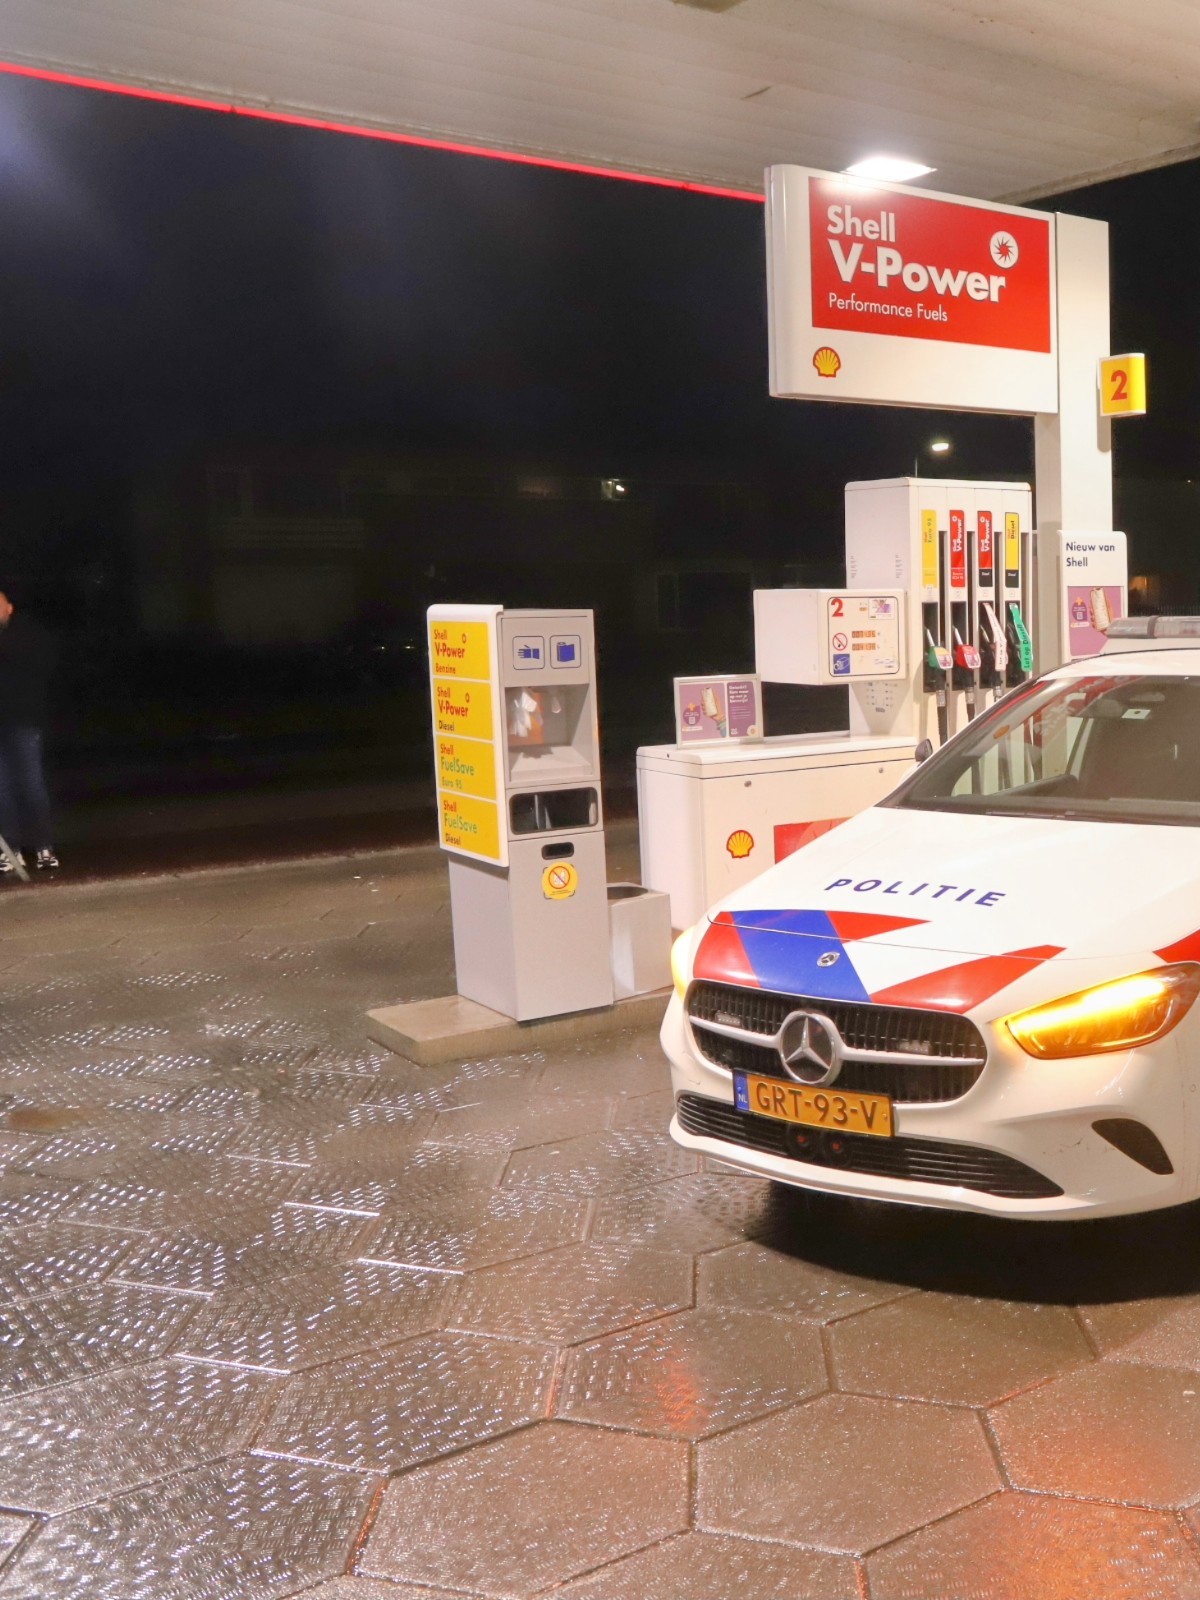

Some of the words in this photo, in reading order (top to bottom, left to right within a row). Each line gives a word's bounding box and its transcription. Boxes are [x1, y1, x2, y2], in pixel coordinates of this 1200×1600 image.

[827, 204, 896, 243] Shell
[827, 239, 1006, 303] V-Power
[829, 292, 913, 318] Performance
[917, 303, 948, 322] Fuels
[1110, 370, 1128, 401] 2
[1066, 542, 1095, 551] Nieuw
[1066, 557, 1088, 566] Shell
[831, 598, 844, 617] 2
[434, 629, 447, 640] Shell
[434, 642, 465, 658] V-Power
[435, 662, 456, 674] Benzine
[437, 686, 451, 698] Shell
[438, 699, 469, 717] V-Power
[439, 720, 455, 731] Diesel
[440, 744, 454, 755] Shell
[441, 756, 475, 776] FuelSave
[443, 800, 457, 812] Shell
[444, 813, 478, 834] FuelSave
[445, 833, 462, 846] Diesel
[824, 878, 1007, 907] POLITIE
[738, 1093, 748, 1103] NL
[756, 1082, 878, 1129] GRT-93-V
